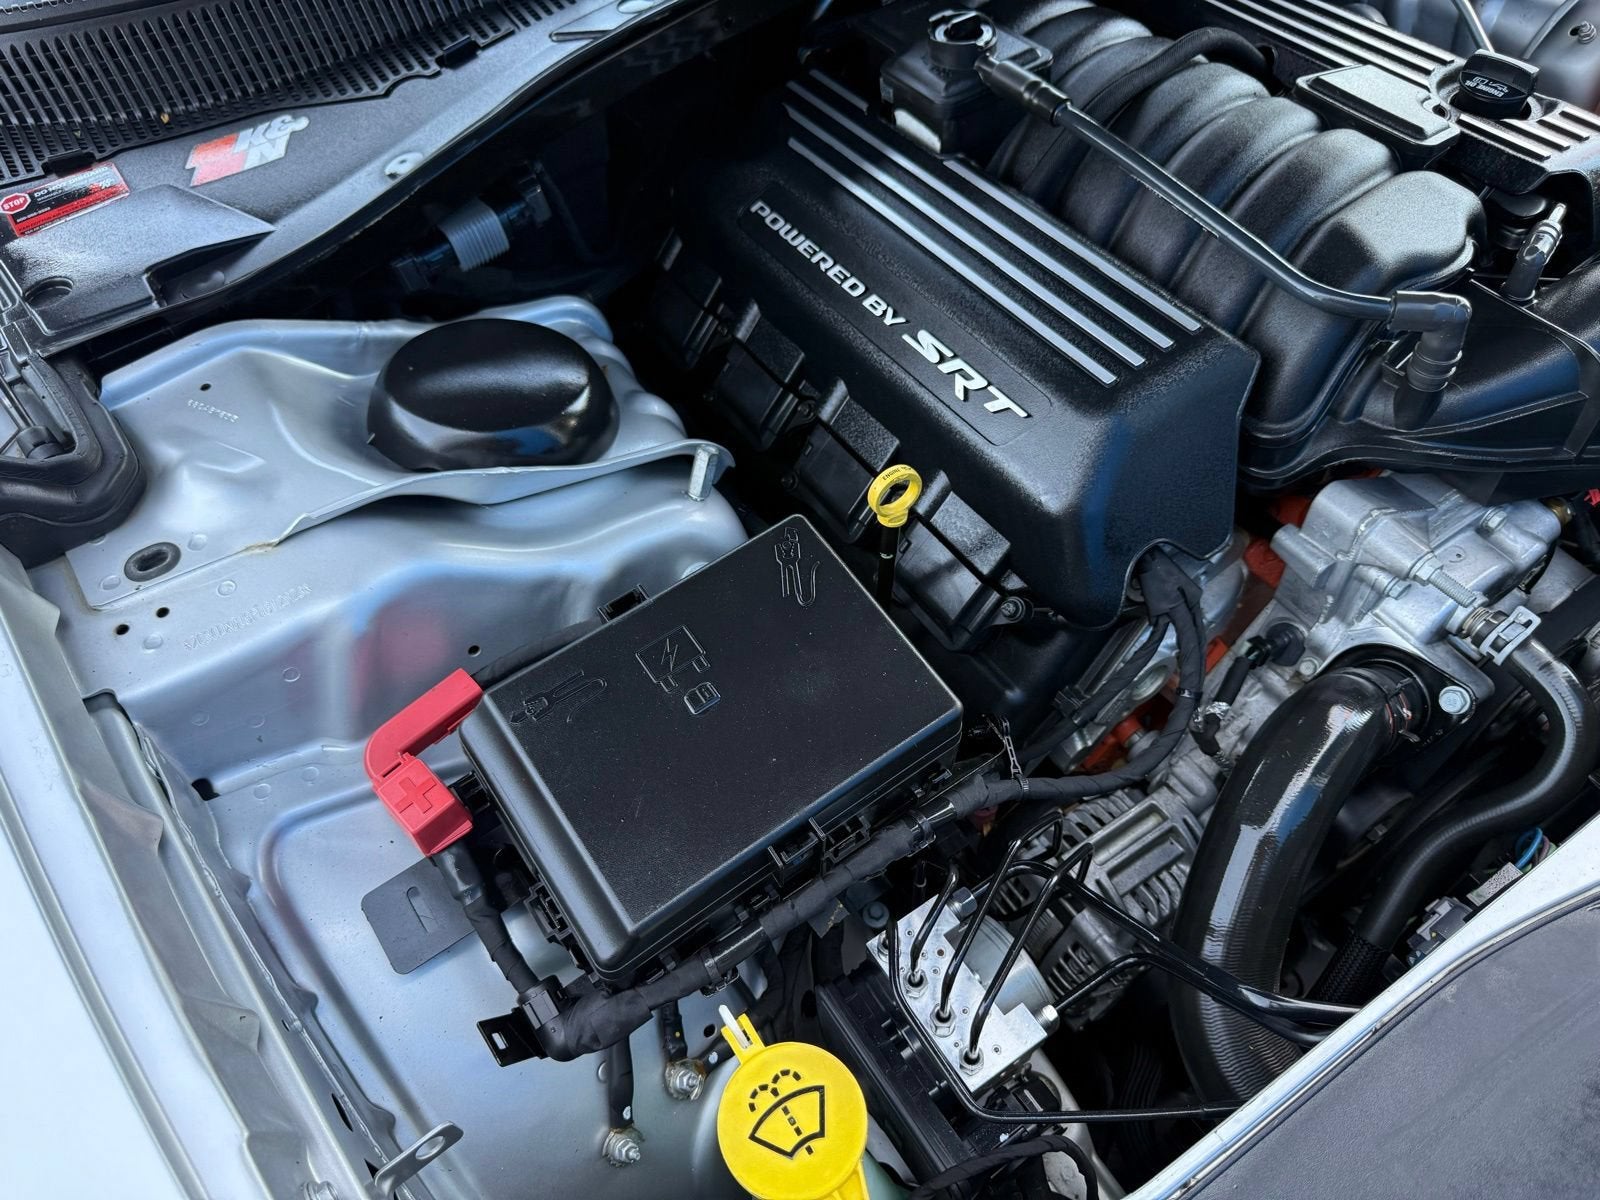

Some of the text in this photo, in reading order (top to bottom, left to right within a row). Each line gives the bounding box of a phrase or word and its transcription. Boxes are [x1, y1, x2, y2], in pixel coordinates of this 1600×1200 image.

[34, 188, 48, 198] DO
[49, 182, 67, 194] NOT
[3, 197, 26, 210] STOP
[750, 201, 1029, 418] POWERED BY SRT
[882, 468, 900, 481] ENGINE
